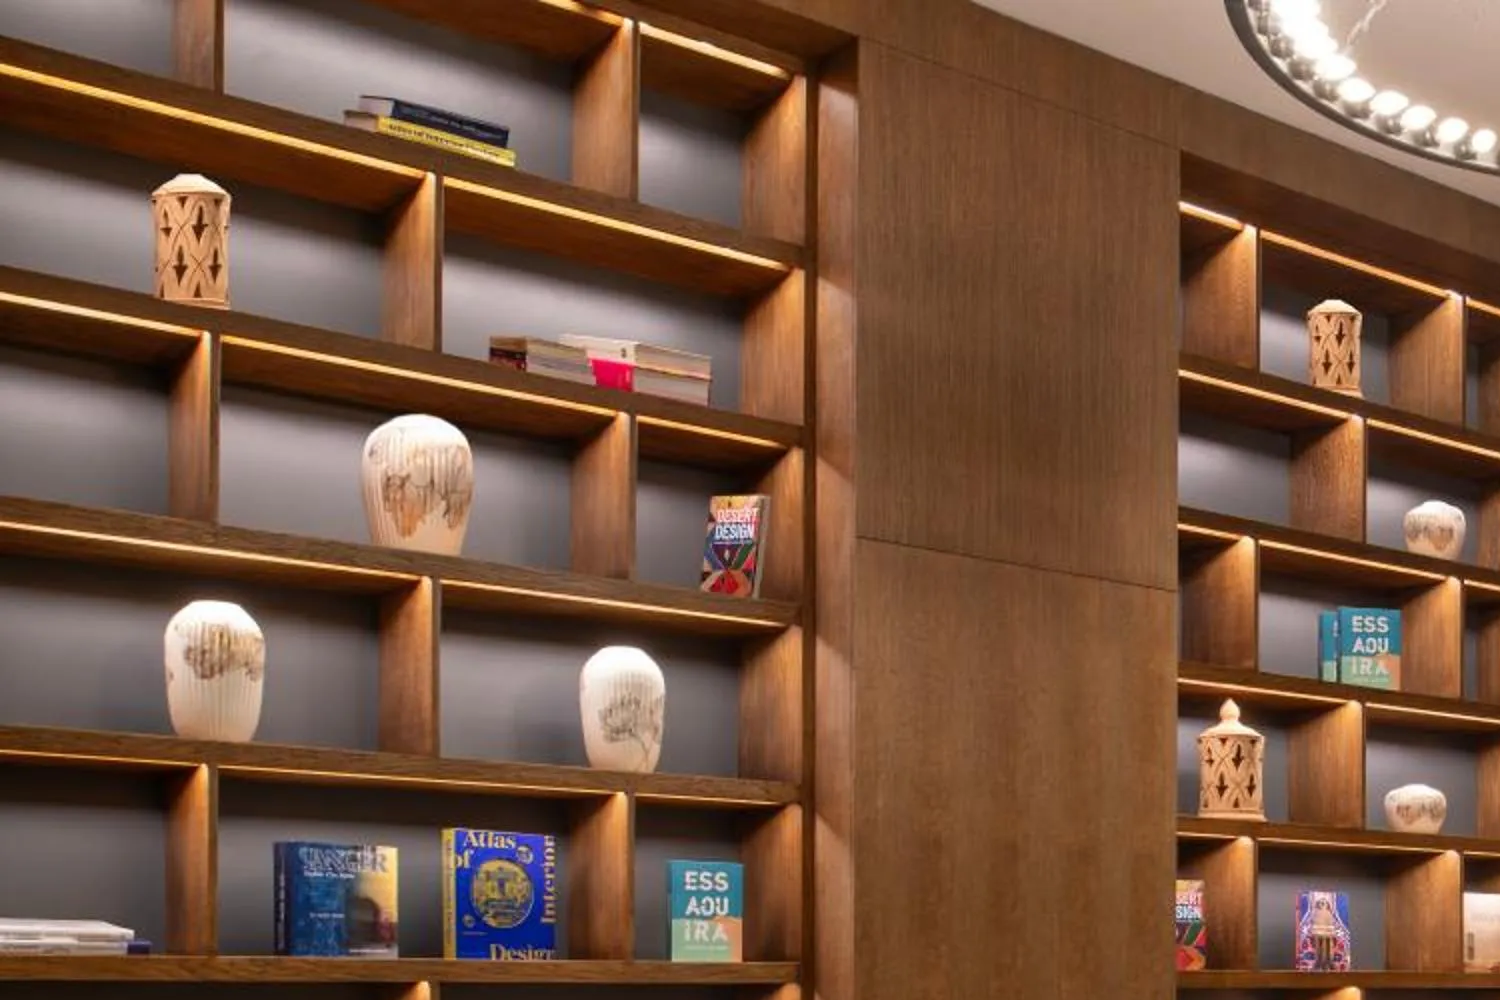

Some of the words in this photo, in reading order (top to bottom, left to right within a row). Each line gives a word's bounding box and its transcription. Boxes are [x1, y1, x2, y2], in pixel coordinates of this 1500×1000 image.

[715, 523, 754, 540] DESIGN
[1351, 615, 1389, 633] ESS
[1352, 637, 1389, 654] AOU
[1351, 656, 1389, 675] IRA
[463, 829, 517, 849] Atlas
[540, 835, 557, 923] Interior
[684, 870, 729, 892] ESS
[685, 896, 729, 917] AOU
[684, 919, 729, 943] IRA
